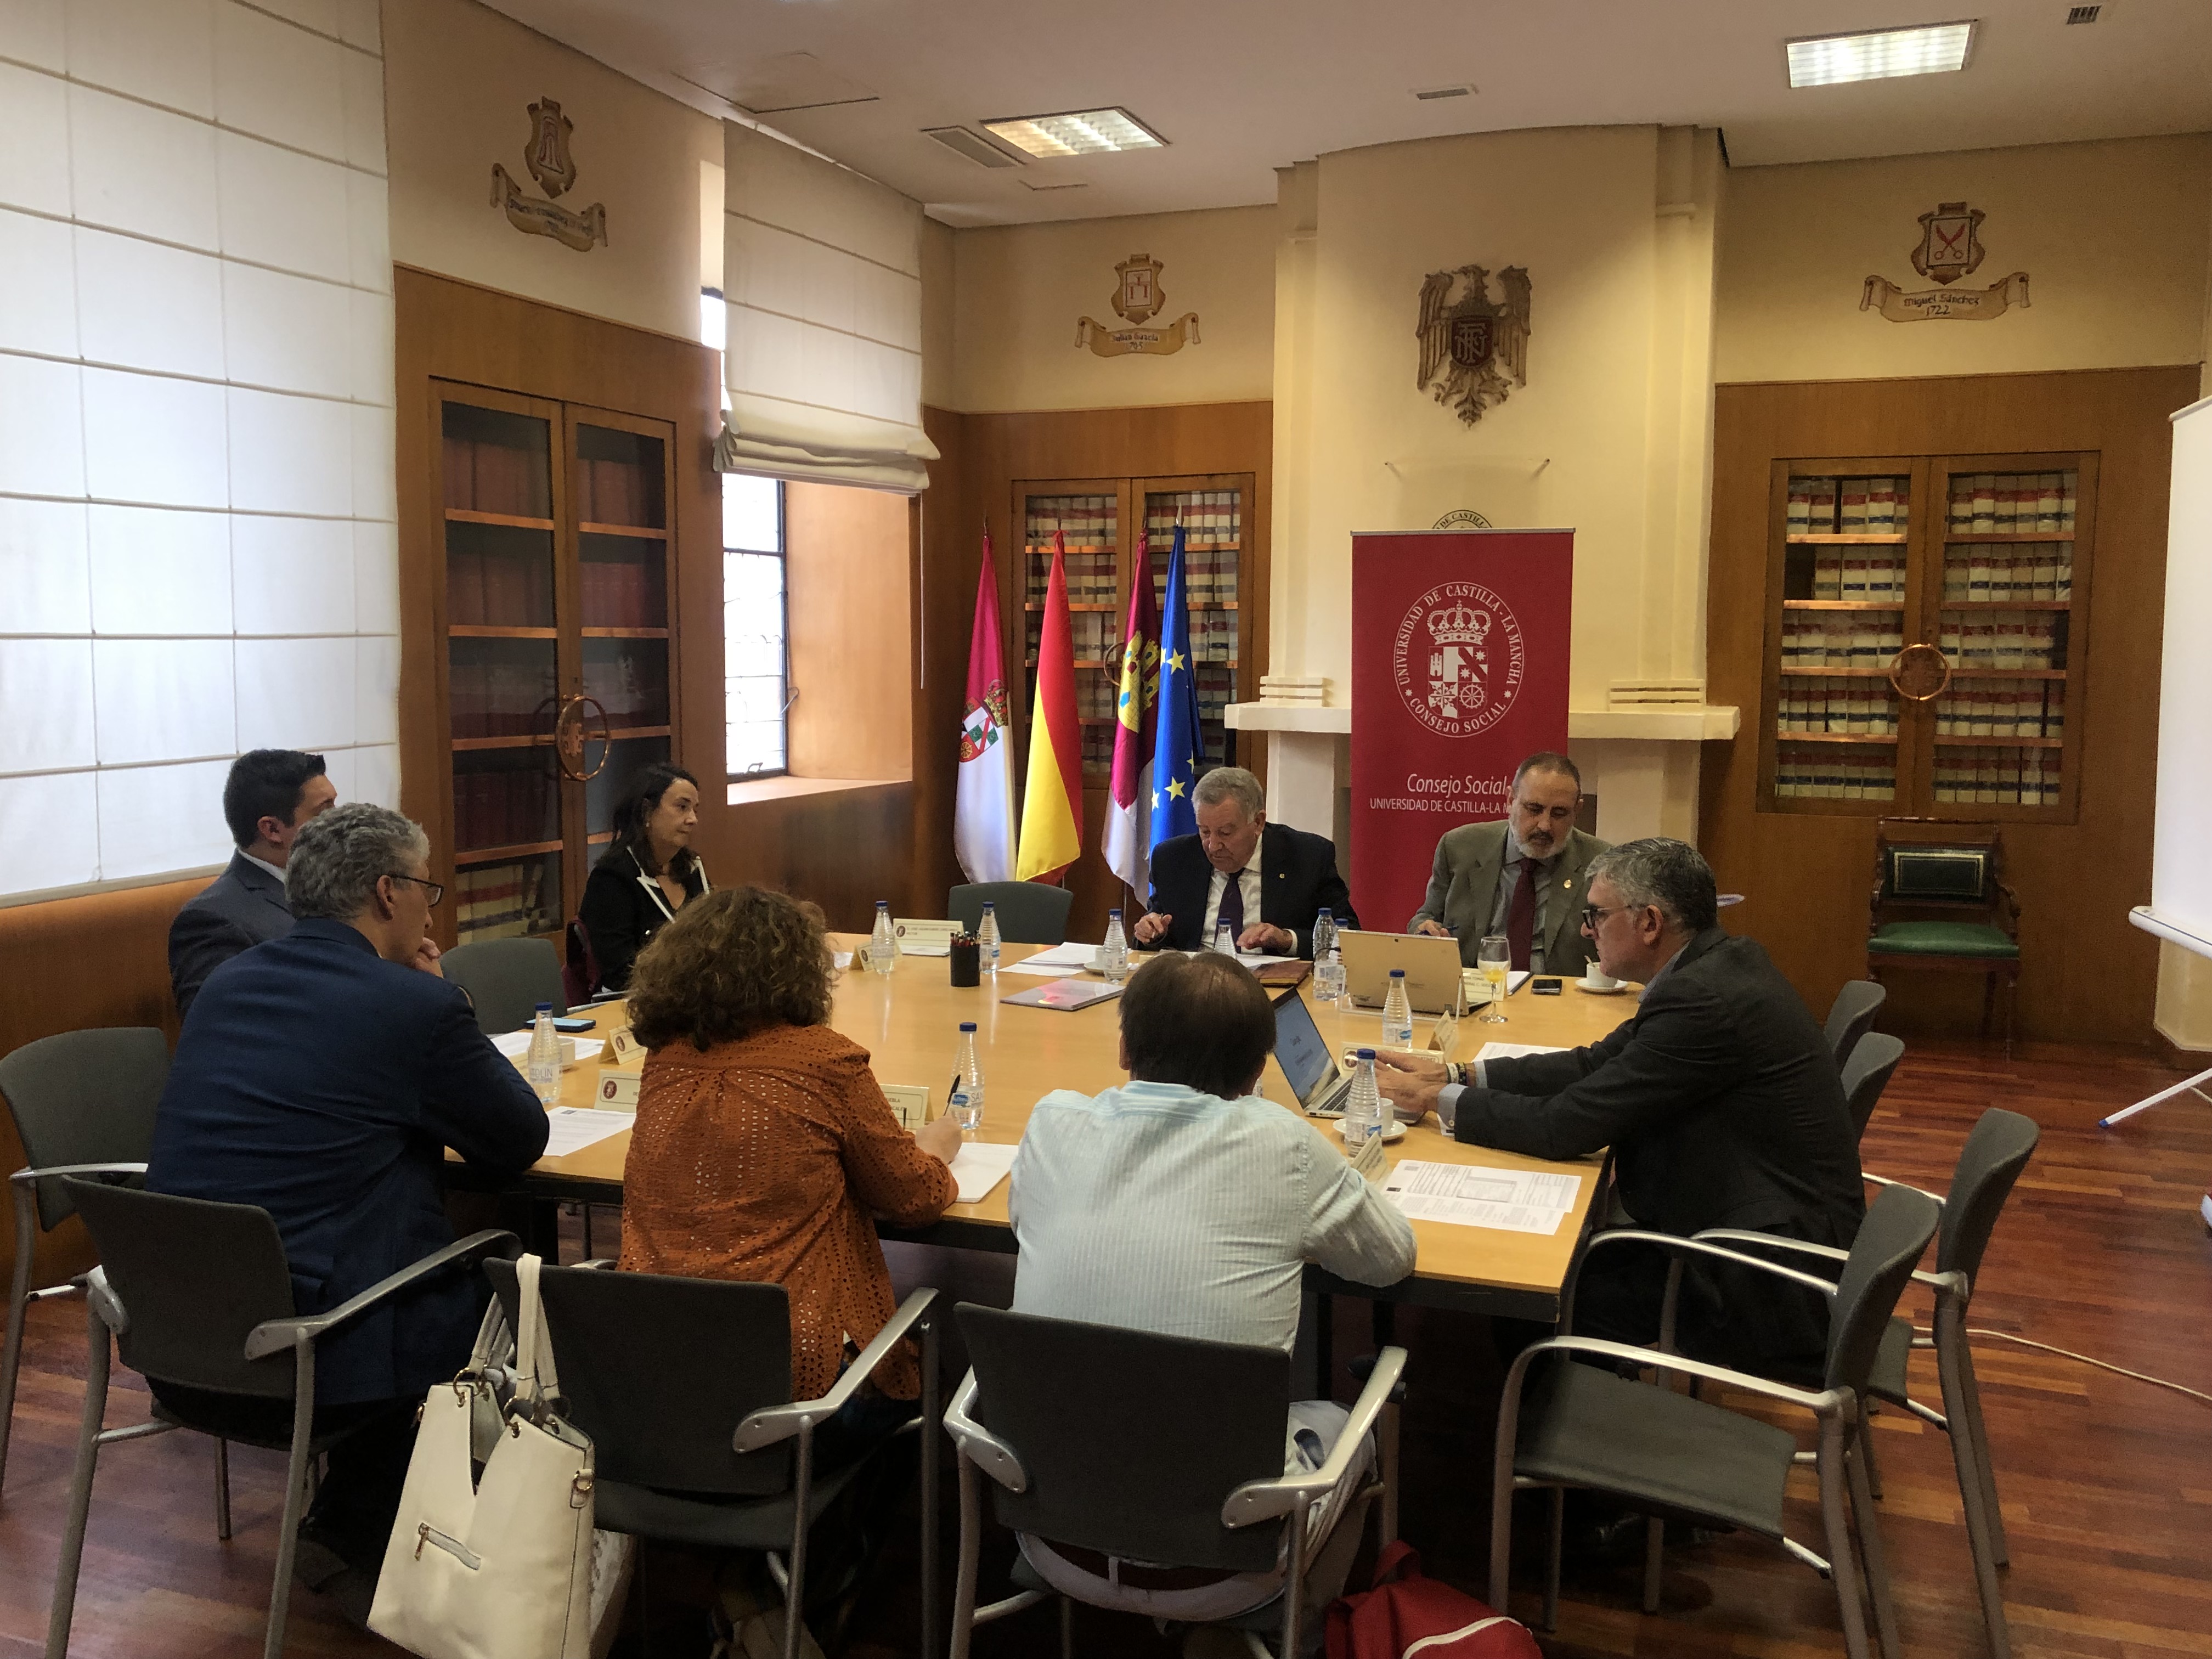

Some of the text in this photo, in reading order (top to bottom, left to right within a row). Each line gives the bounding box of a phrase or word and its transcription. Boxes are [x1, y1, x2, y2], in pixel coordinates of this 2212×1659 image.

[1440, 512, 1487, 528] DE CASTILL
[1424, 590, 1442, 607] DE
[1446, 585, 1500, 612] CASTILLA
[1501, 615, 1515, 633] LA
[1396, 606, 1423, 685] UNIVERSIDAD
[1506, 633, 1521, 684] MANCHA
[1410, 698, 1506, 733] CONSEJO SOCIAL
[1407, 774, 1507, 798] Consejo Social
[1370, 798, 1429, 811] UNIVERSIDAD
[1430, 800, 1442, 811] DE
[1444, 800, 1501, 814] CASTILLA-LA
